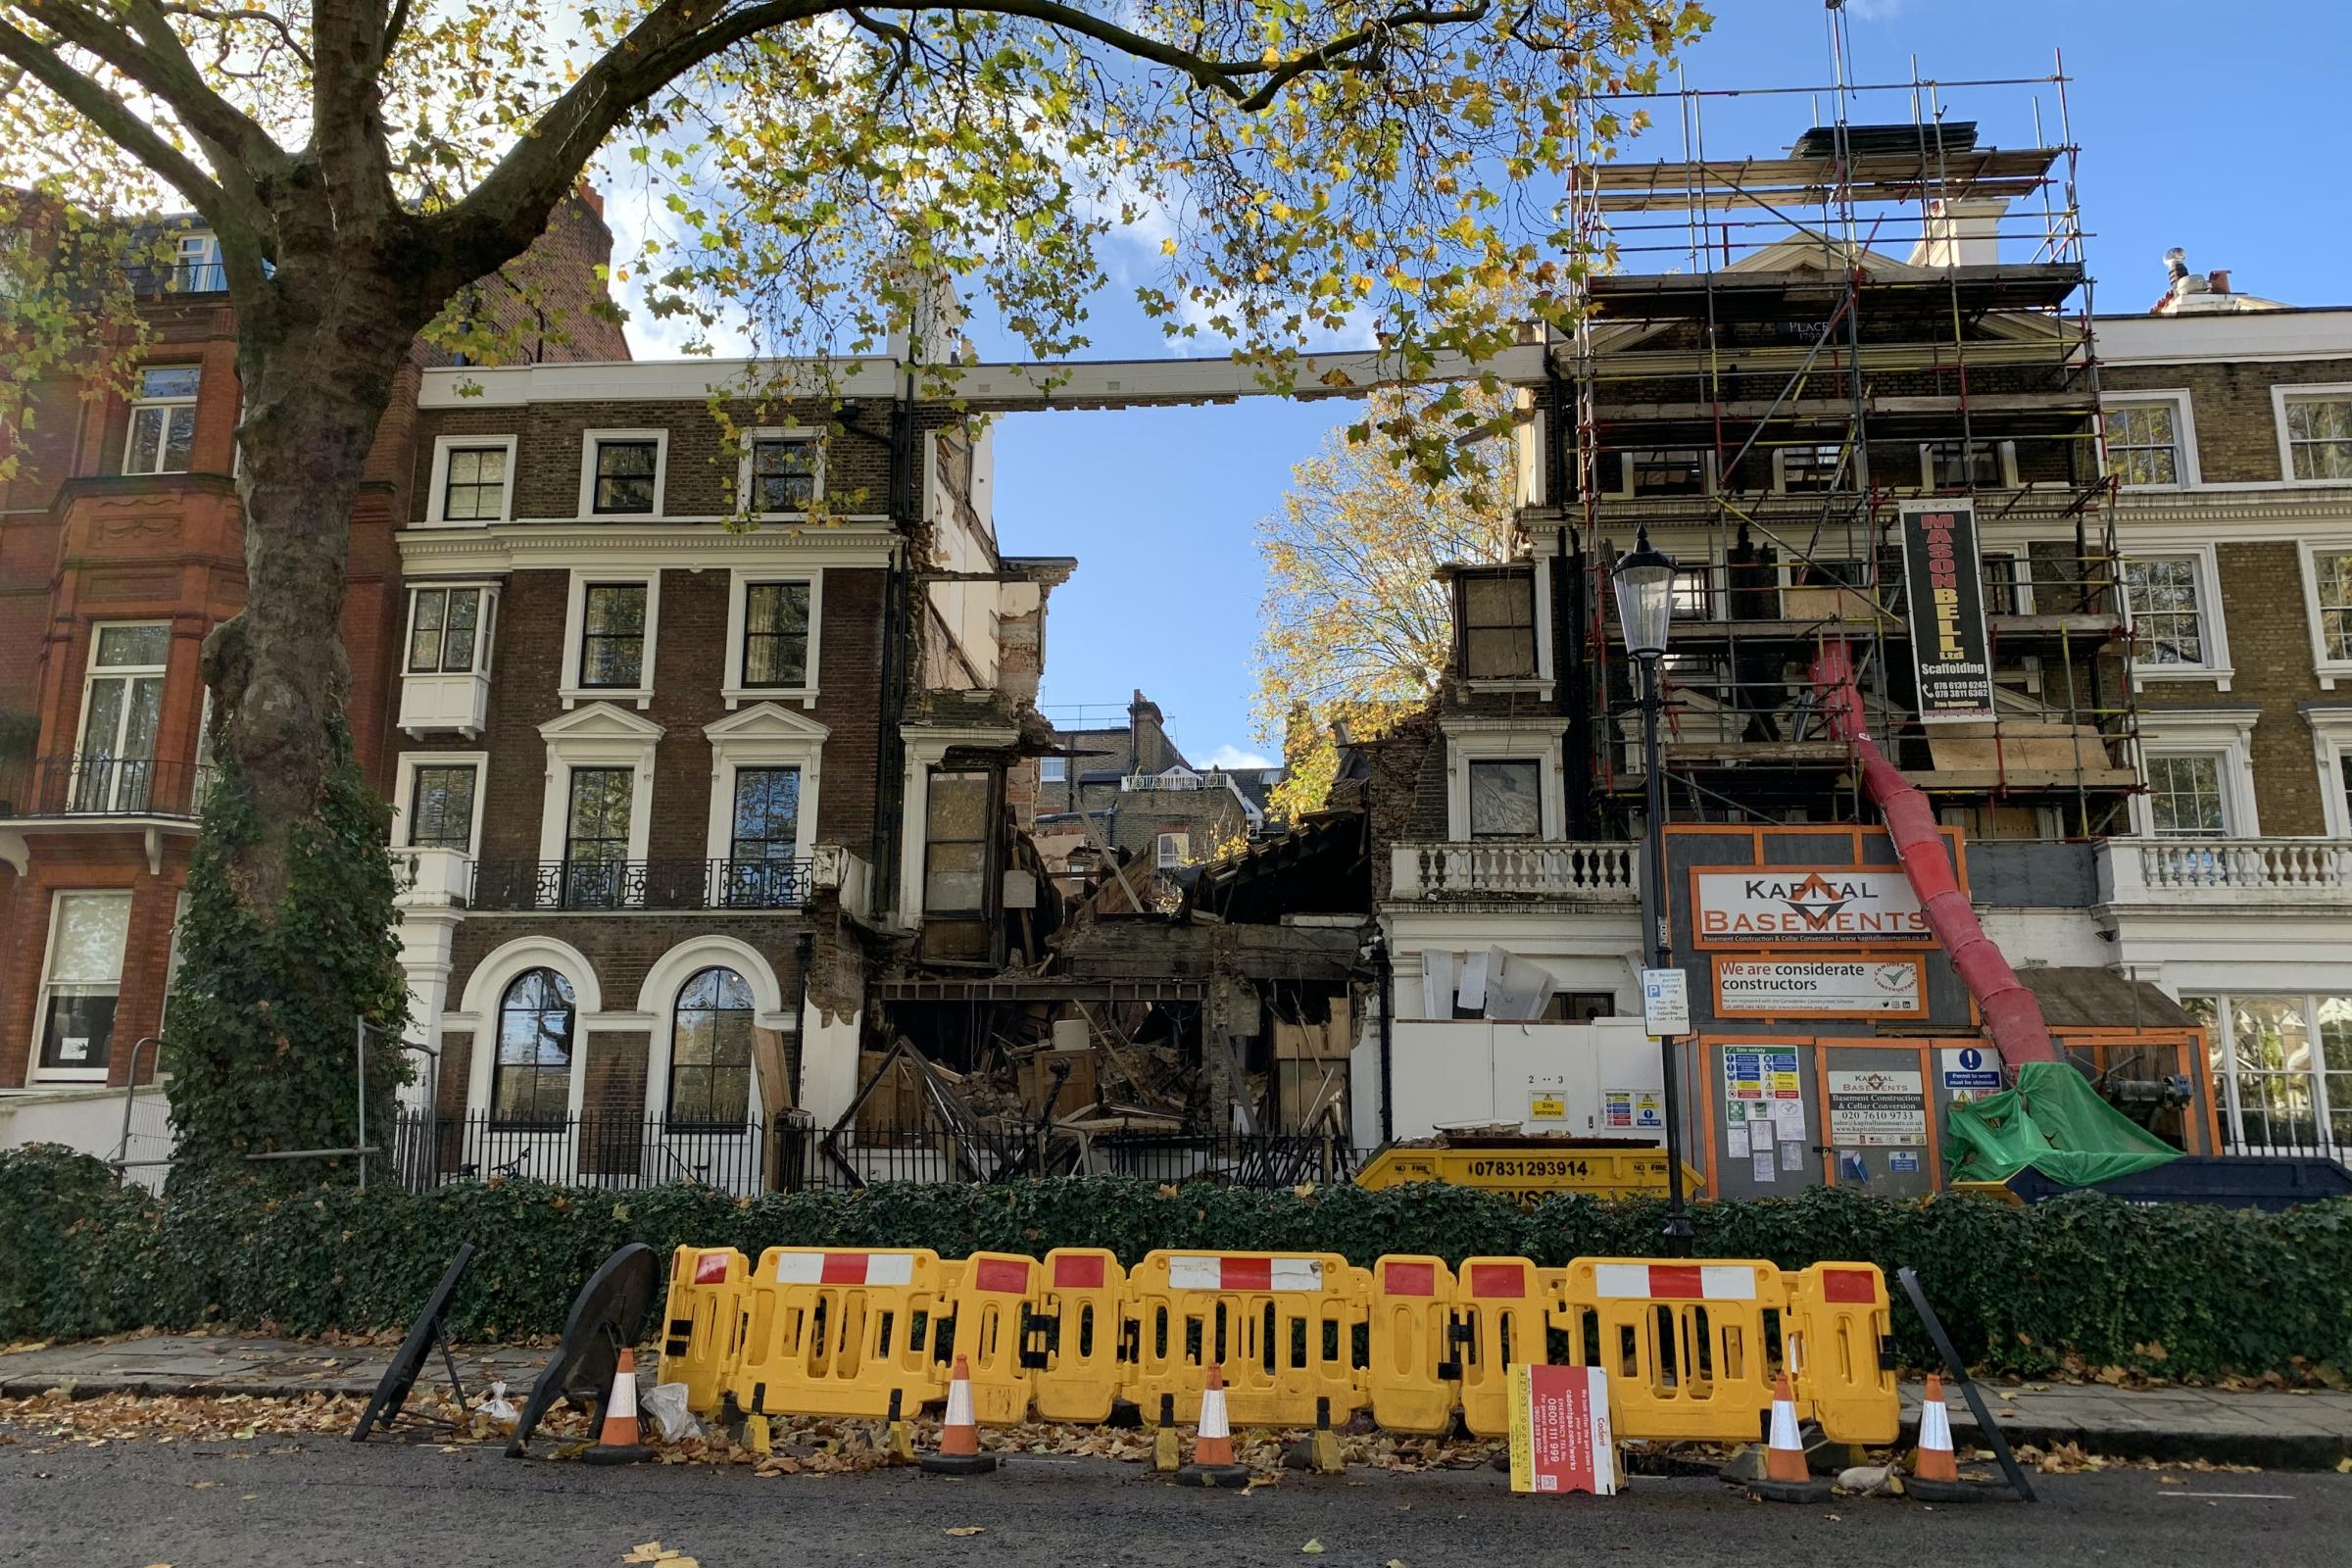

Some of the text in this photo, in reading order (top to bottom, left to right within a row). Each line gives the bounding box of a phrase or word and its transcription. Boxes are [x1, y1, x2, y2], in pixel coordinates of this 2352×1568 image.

[1921, 514, 1964, 652] MASON BELL
[1922, 662, 1984, 674] Scaffolding
[1744, 880, 1879, 899] KAPITAL
[1704, 910, 1927, 931] BASEMENTS
[1721, 962, 1865, 976] We are considerate
[1722, 978, 1817, 991] constructors
[1529, 1075, 1563, 1084] 2 3
[1863, 1111, 1887, 1120] 7610
[1411, 1164, 1428, 1173] FIRE
[1557, 1397, 1566, 1438] EMERGENCY
[1547, 1397, 1560, 1462] 0800 111 999
[1565, 1389, 1577, 1471] cadentgas.com/works
